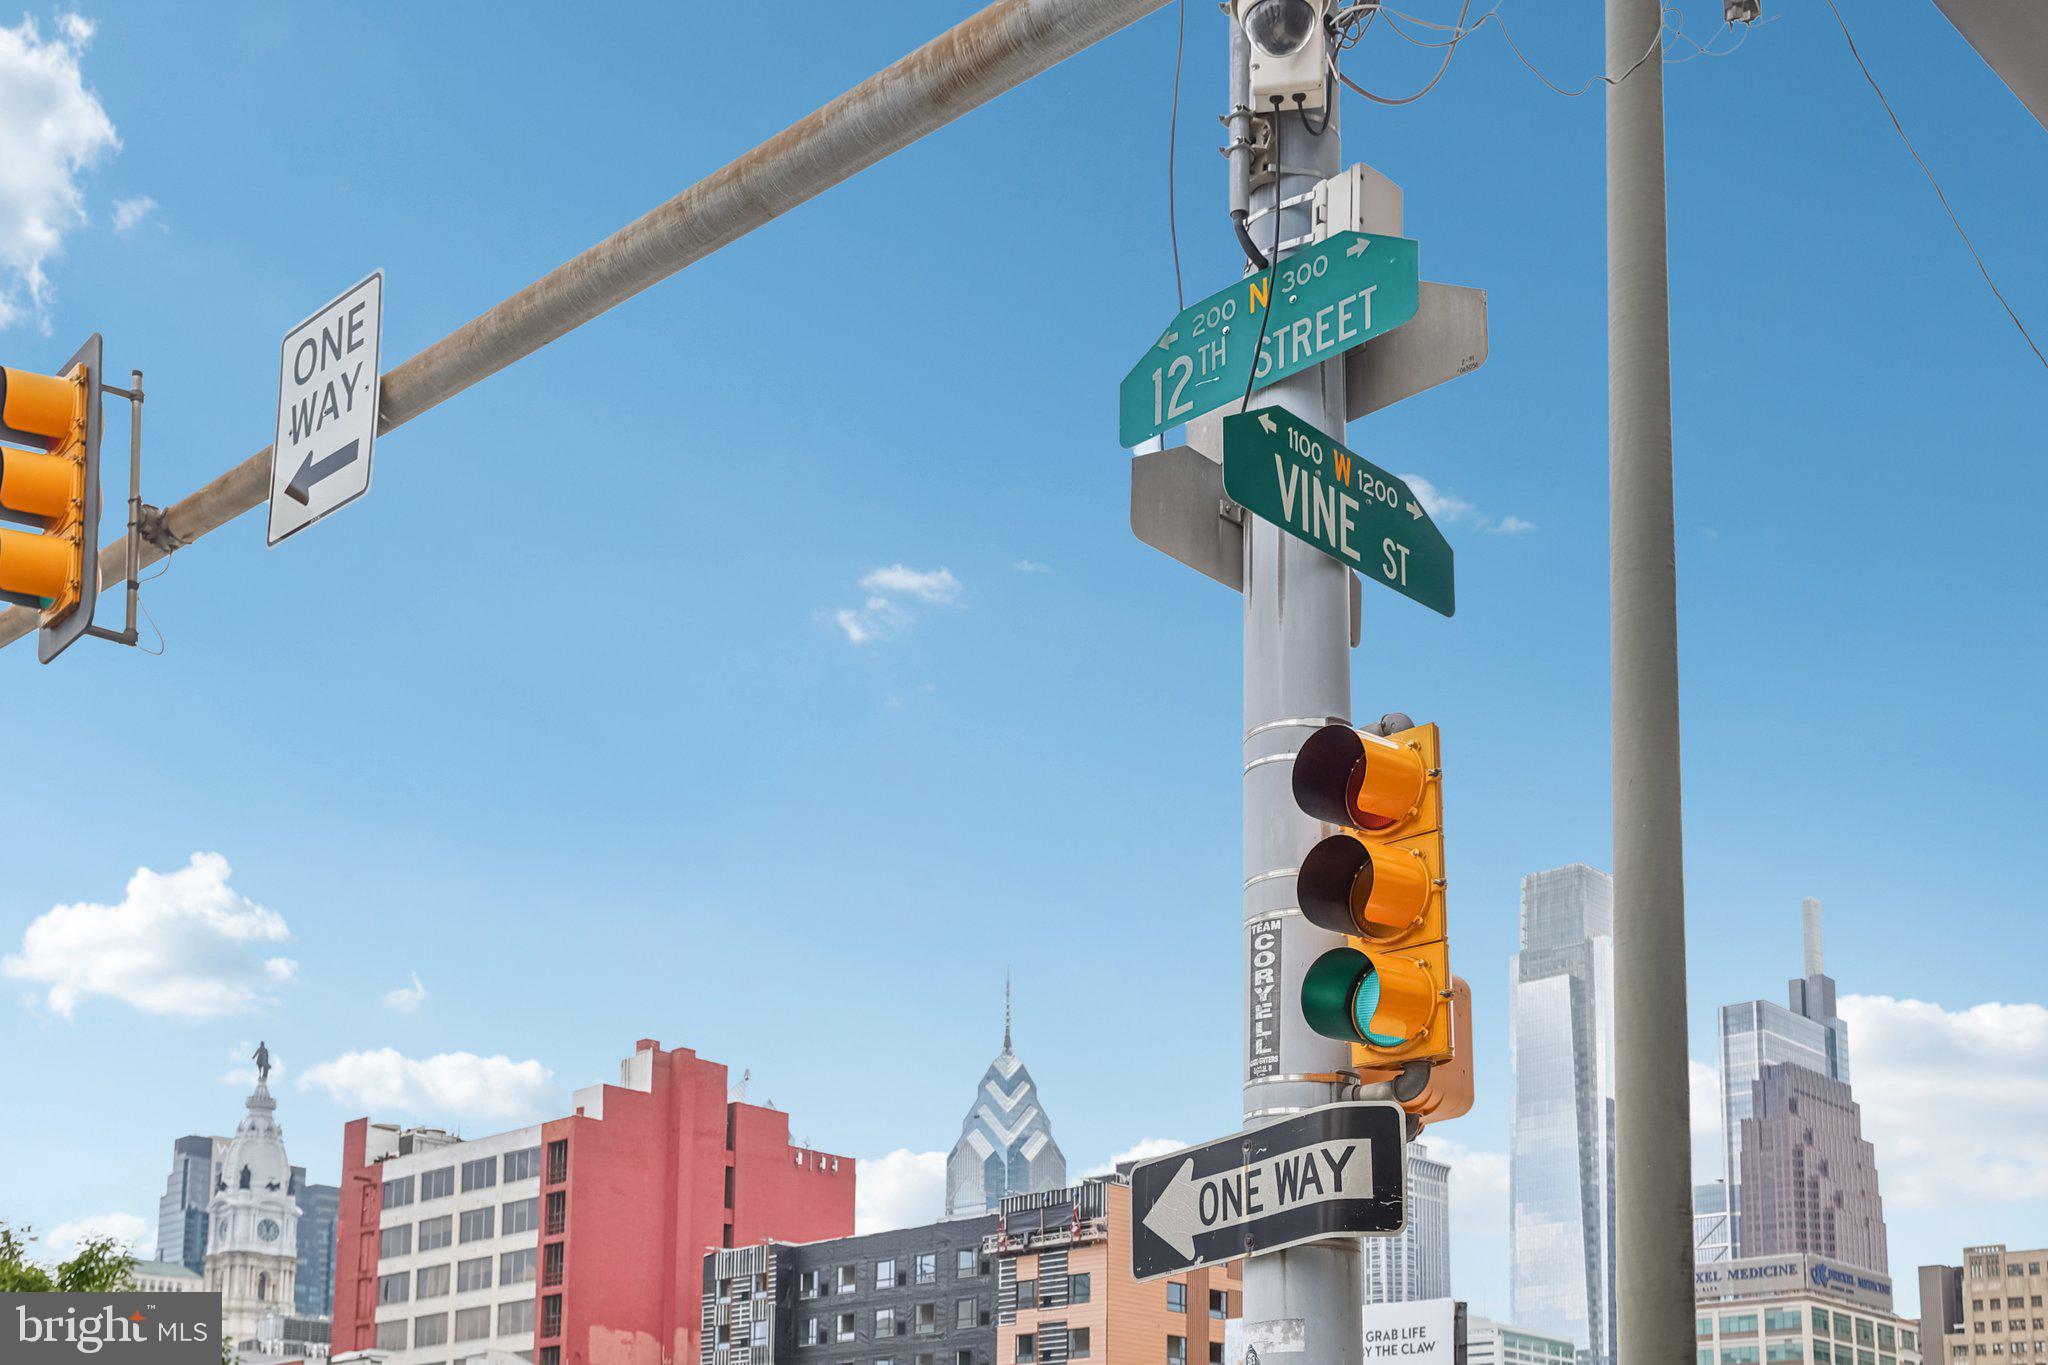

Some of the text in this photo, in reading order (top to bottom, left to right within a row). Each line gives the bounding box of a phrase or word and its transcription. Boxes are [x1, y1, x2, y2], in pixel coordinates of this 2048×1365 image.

[1192, 255, 1328, 337] 200 N 300
[293, 300, 366, 386] ONE
[1152, 284, 1378, 426] 12TH STREET
[291, 361, 363, 446] WAY
[1287, 427, 1398, 509] 1100 W 1200
[1274, 453, 1410, 587] VINE ST
[1251, 919, 1281, 935] TEAM
[1253, 933, 1276, 1055] CORYELL
[1199, 1145, 1357, 1226] ONE WAY
[1695, 1263, 1798, 1284] XEL MEDICINE
[1828, 1268, 1857, 1285] DREXEL
[1857, 1277, 1892, 1296] MEDICINE
[1365, 1326, 1426, 1342] GRAB LIFE
[1375, 1344, 1398, 1357] THE
[1401, 1341, 1436, 1355] CLAW
